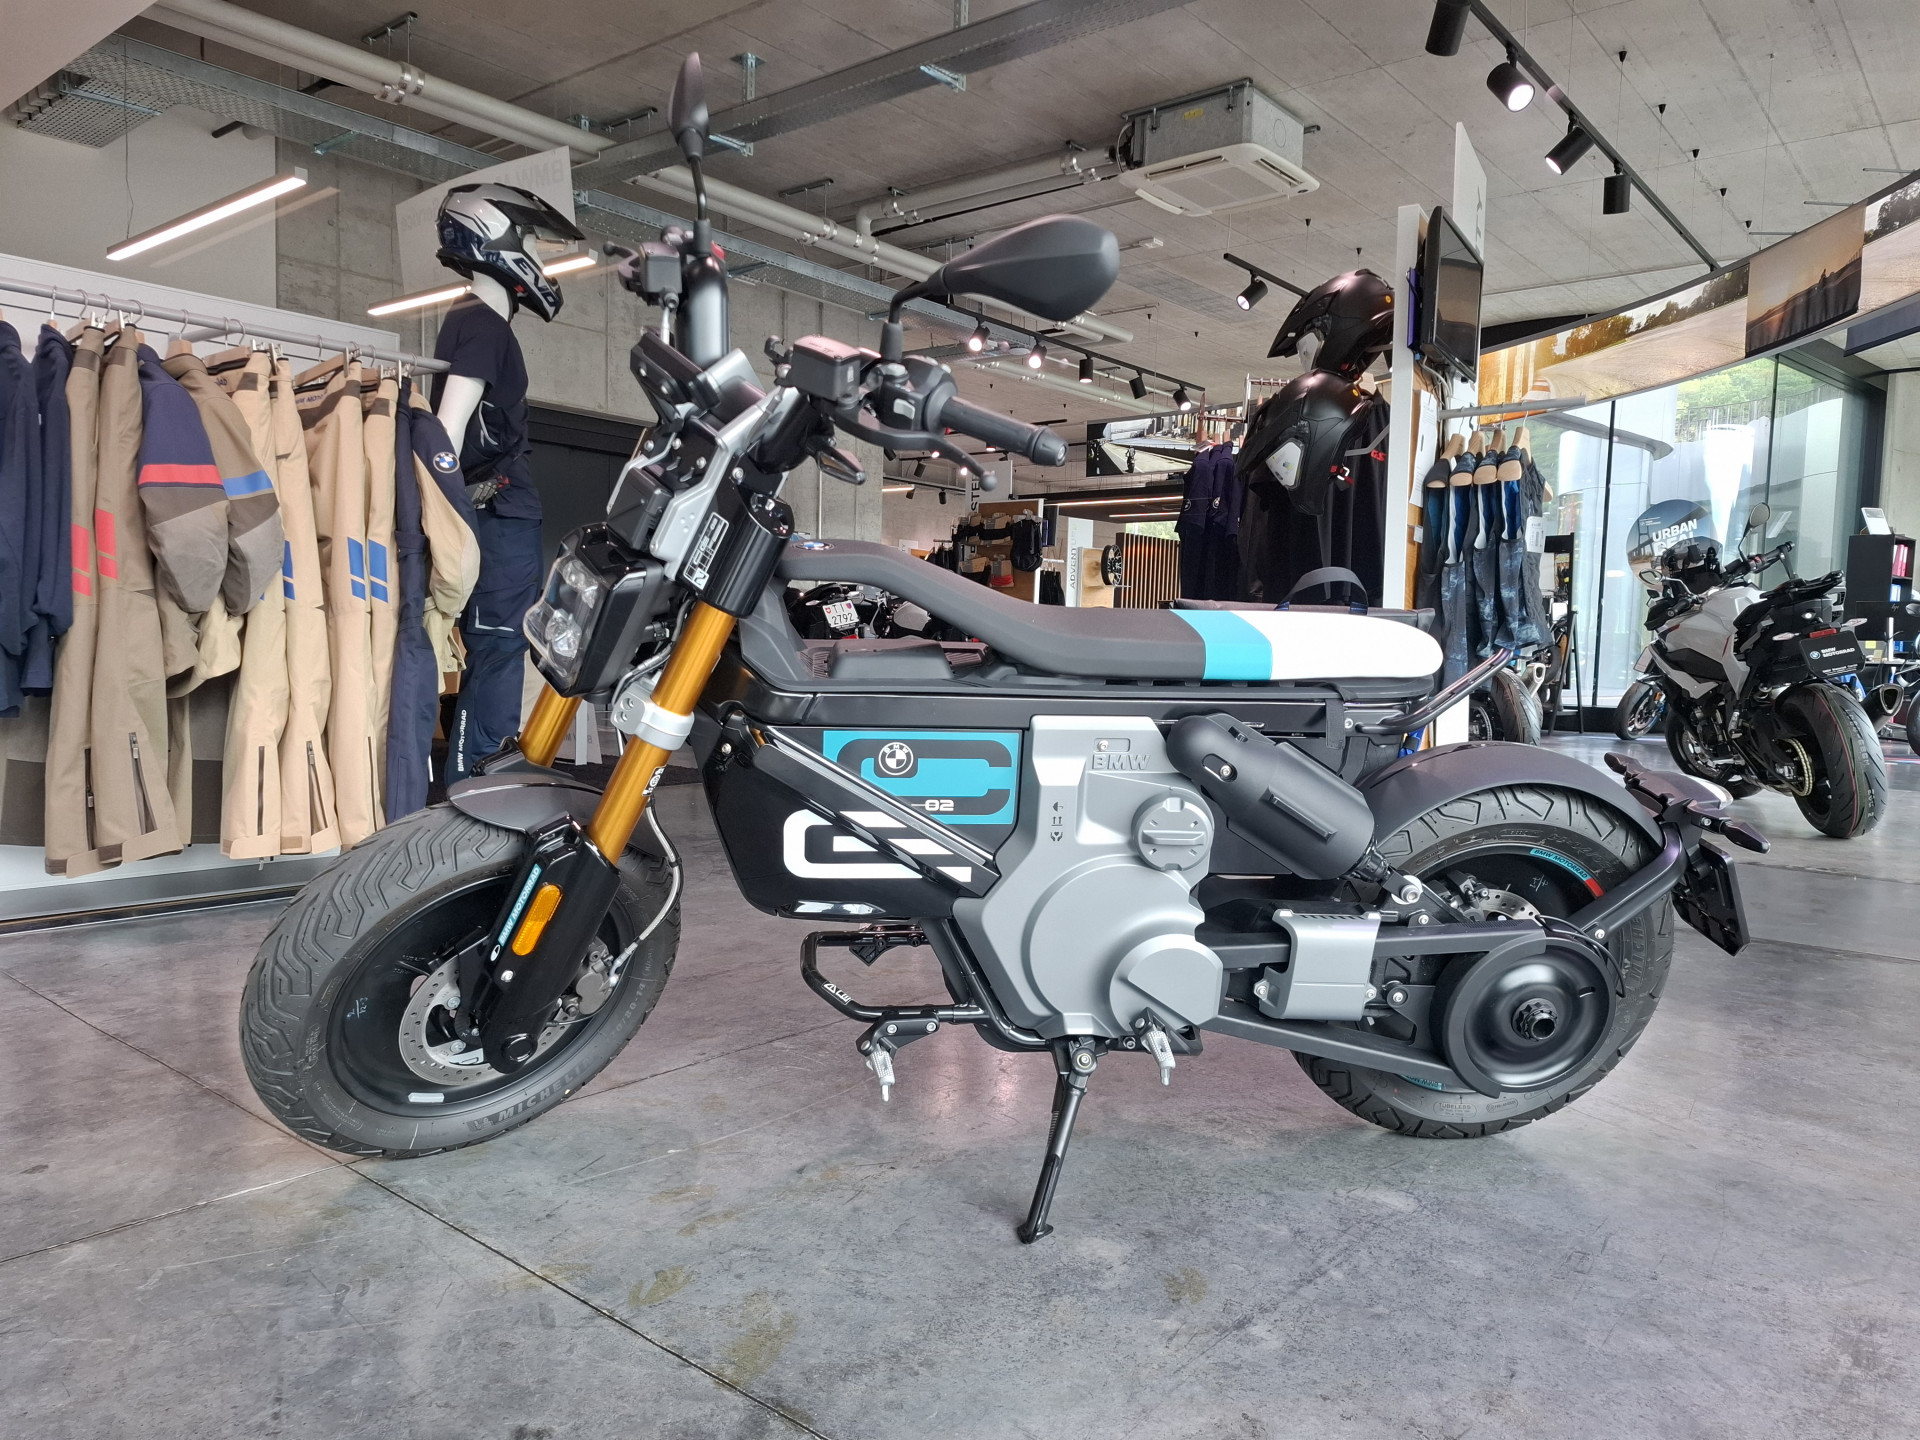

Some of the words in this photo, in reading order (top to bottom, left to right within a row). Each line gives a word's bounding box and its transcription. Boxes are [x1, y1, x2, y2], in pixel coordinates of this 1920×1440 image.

[1652, 518, 1698, 542] URBAN
[832, 612, 855, 625] 2792
[458, 709, 467, 752] MOTORRAD
[457, 753, 465, 772] BMW
[1091, 754, 1151, 770] BMW
[1533, 848, 1554, 858] BMW
[1551, 855, 1589, 879] MOTORRAD
[499, 918, 514, 947] BMW
[511, 867, 540, 920] MOTORRAD
